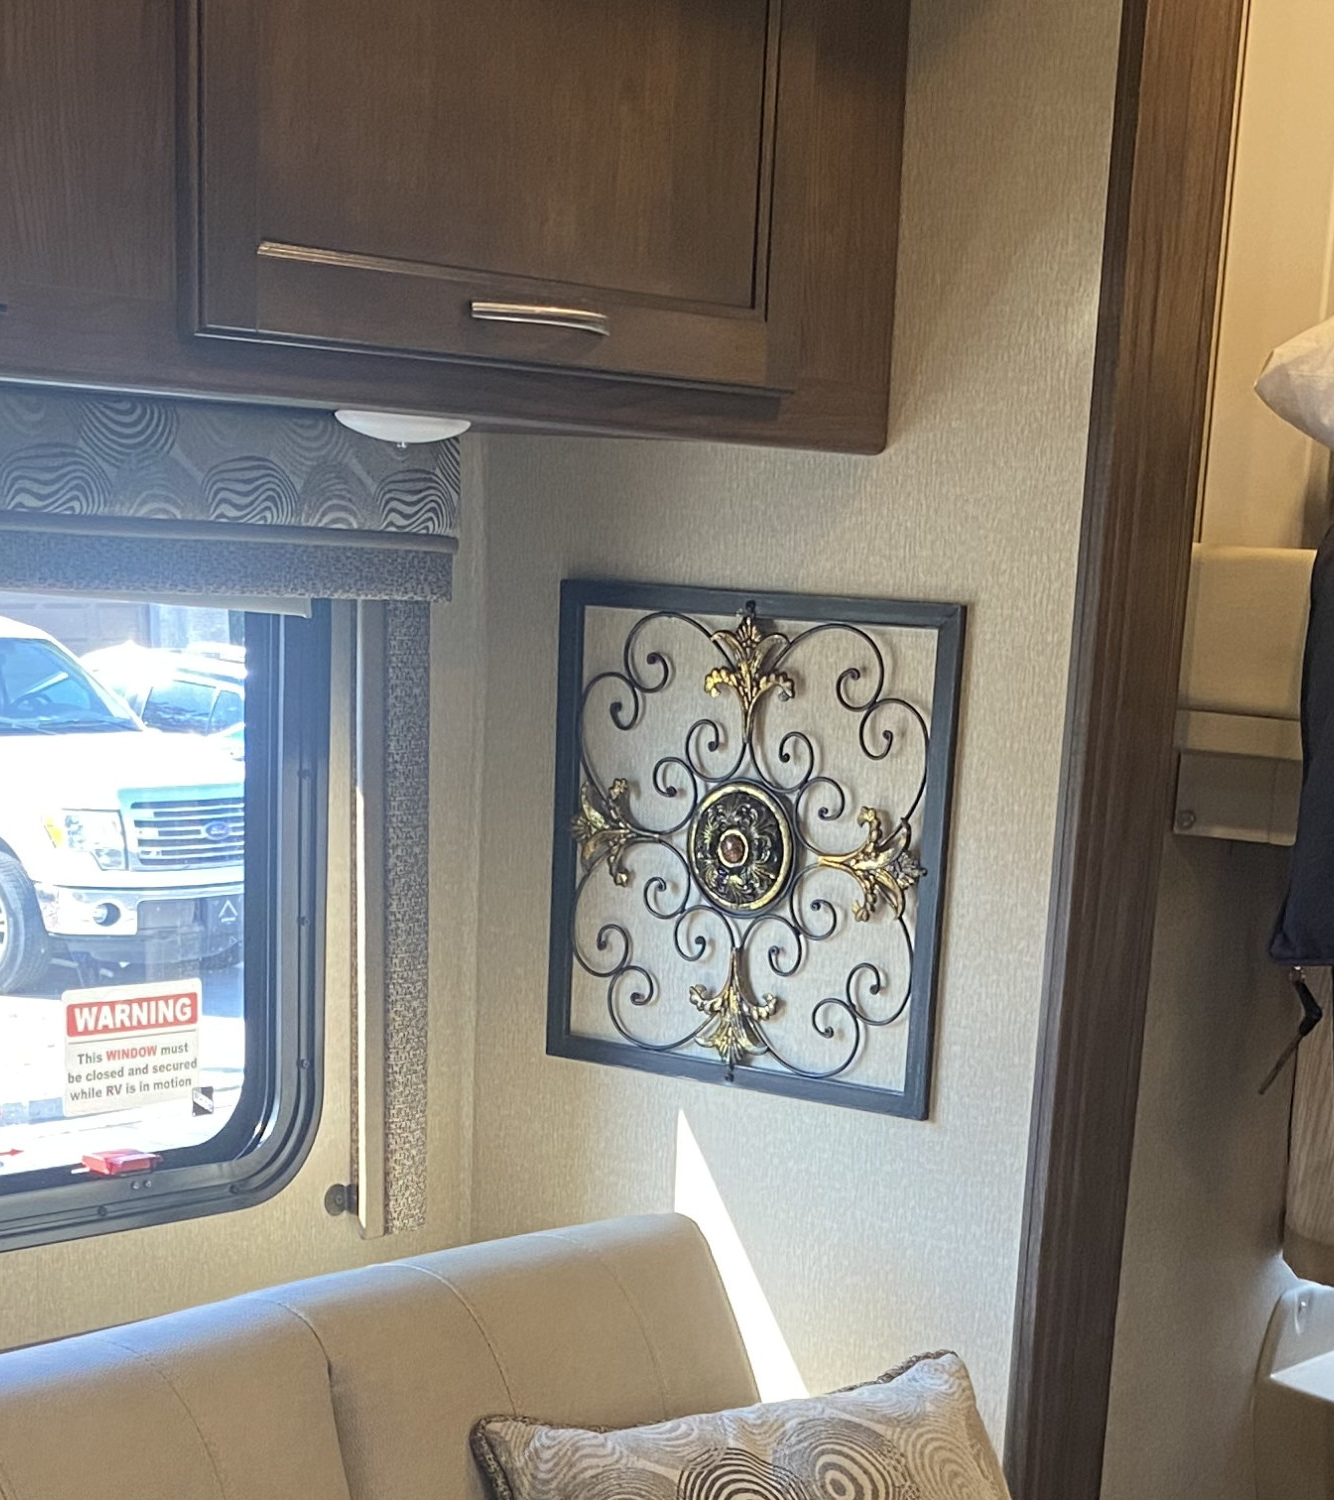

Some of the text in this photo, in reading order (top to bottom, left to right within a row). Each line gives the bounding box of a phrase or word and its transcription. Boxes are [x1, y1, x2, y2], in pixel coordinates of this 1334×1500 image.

[73, 997, 192, 1033] WARNING
[77, 1042, 189, 1065] This WINDOW must
[67, 1057, 197, 1083] be closed and secured
[70, 1076, 192, 1101] while RV is in motion
